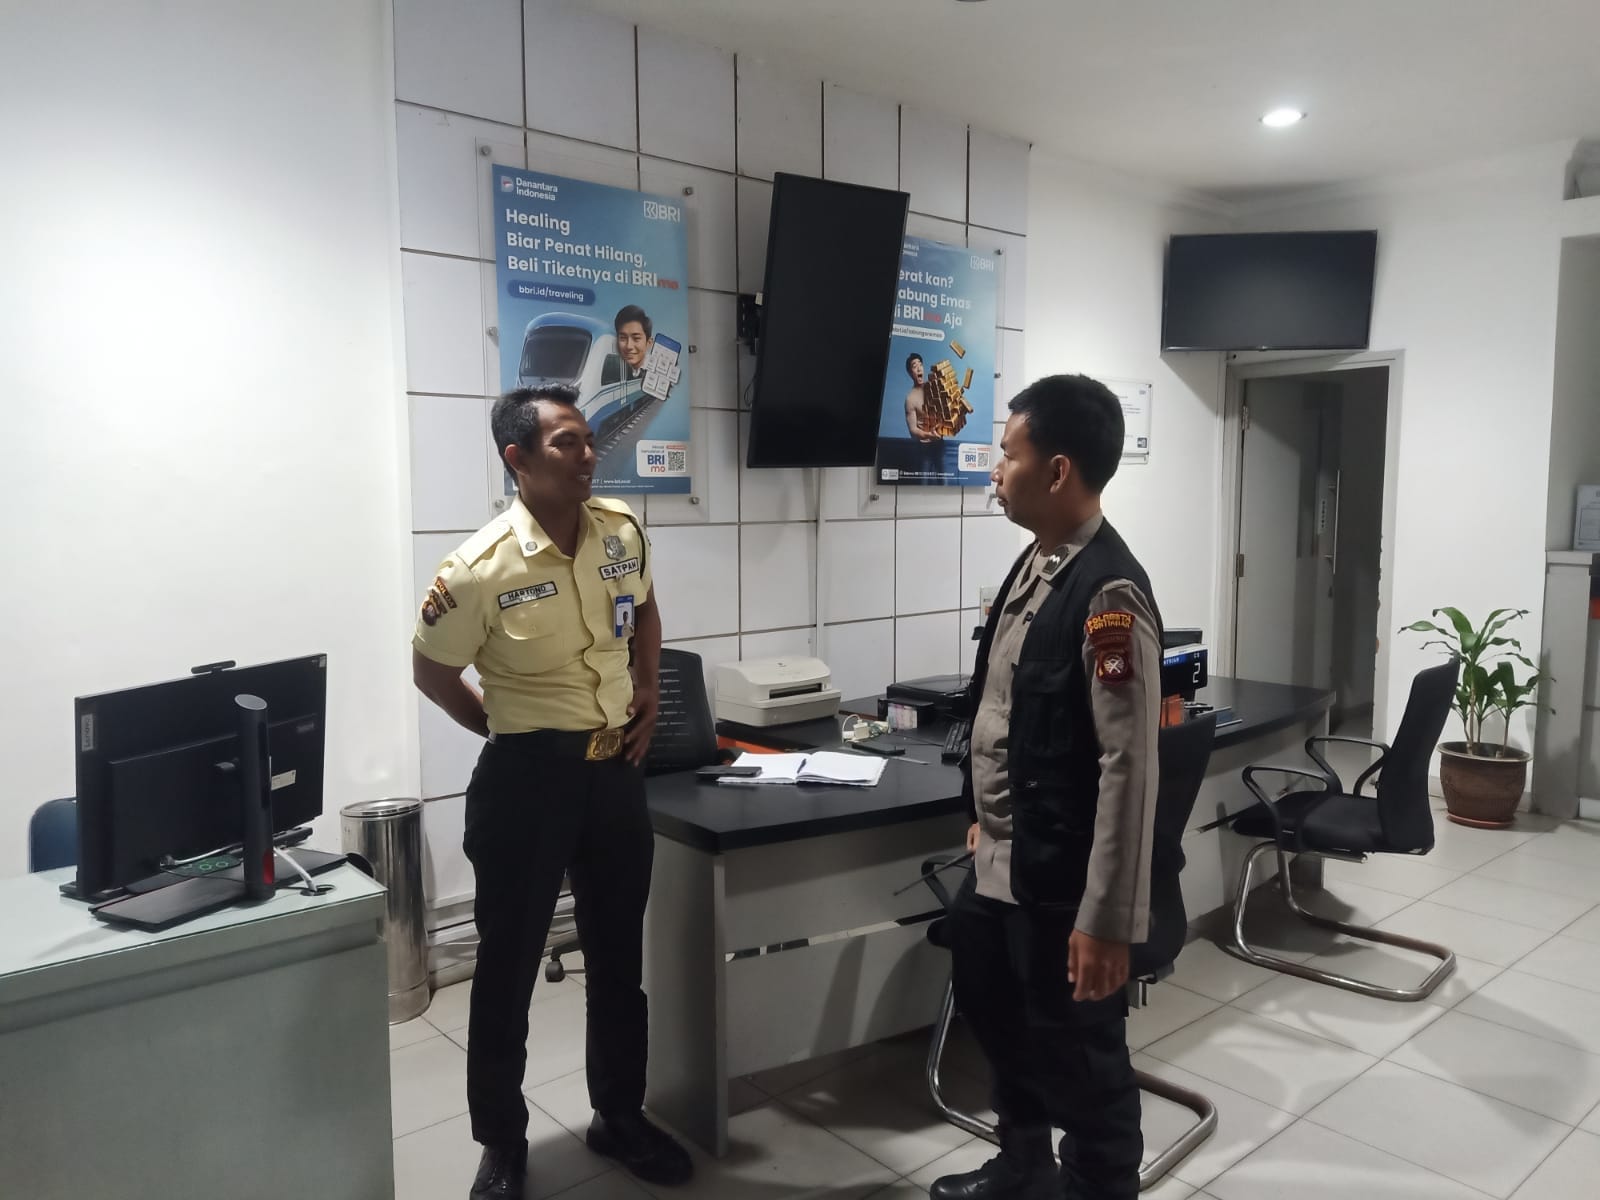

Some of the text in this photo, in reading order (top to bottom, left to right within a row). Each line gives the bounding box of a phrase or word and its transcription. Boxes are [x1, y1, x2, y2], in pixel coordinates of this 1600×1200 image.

[515, 177, 558, 193] Danantara
[516, 186, 556, 201] Indonesia
[506, 208, 570, 235] Healing
[658, 204, 680, 223] BRI
[506, 232, 647, 267] Biar Penat Hilang,
[508, 255, 538, 273] Beli
[542, 260, 611, 284] Tiketnya
[614, 269, 628, 284] di
[898, 269, 954, 288] erat kan?
[518, 285, 584, 303] bbri.id/traveling
[898, 287, 970, 310] abung Emas
[943, 313, 962, 328] Aja
[647, 454, 665, 465] BRI
[650, 465, 666, 473] mo
[1192, 662, 1201, 684] 2
